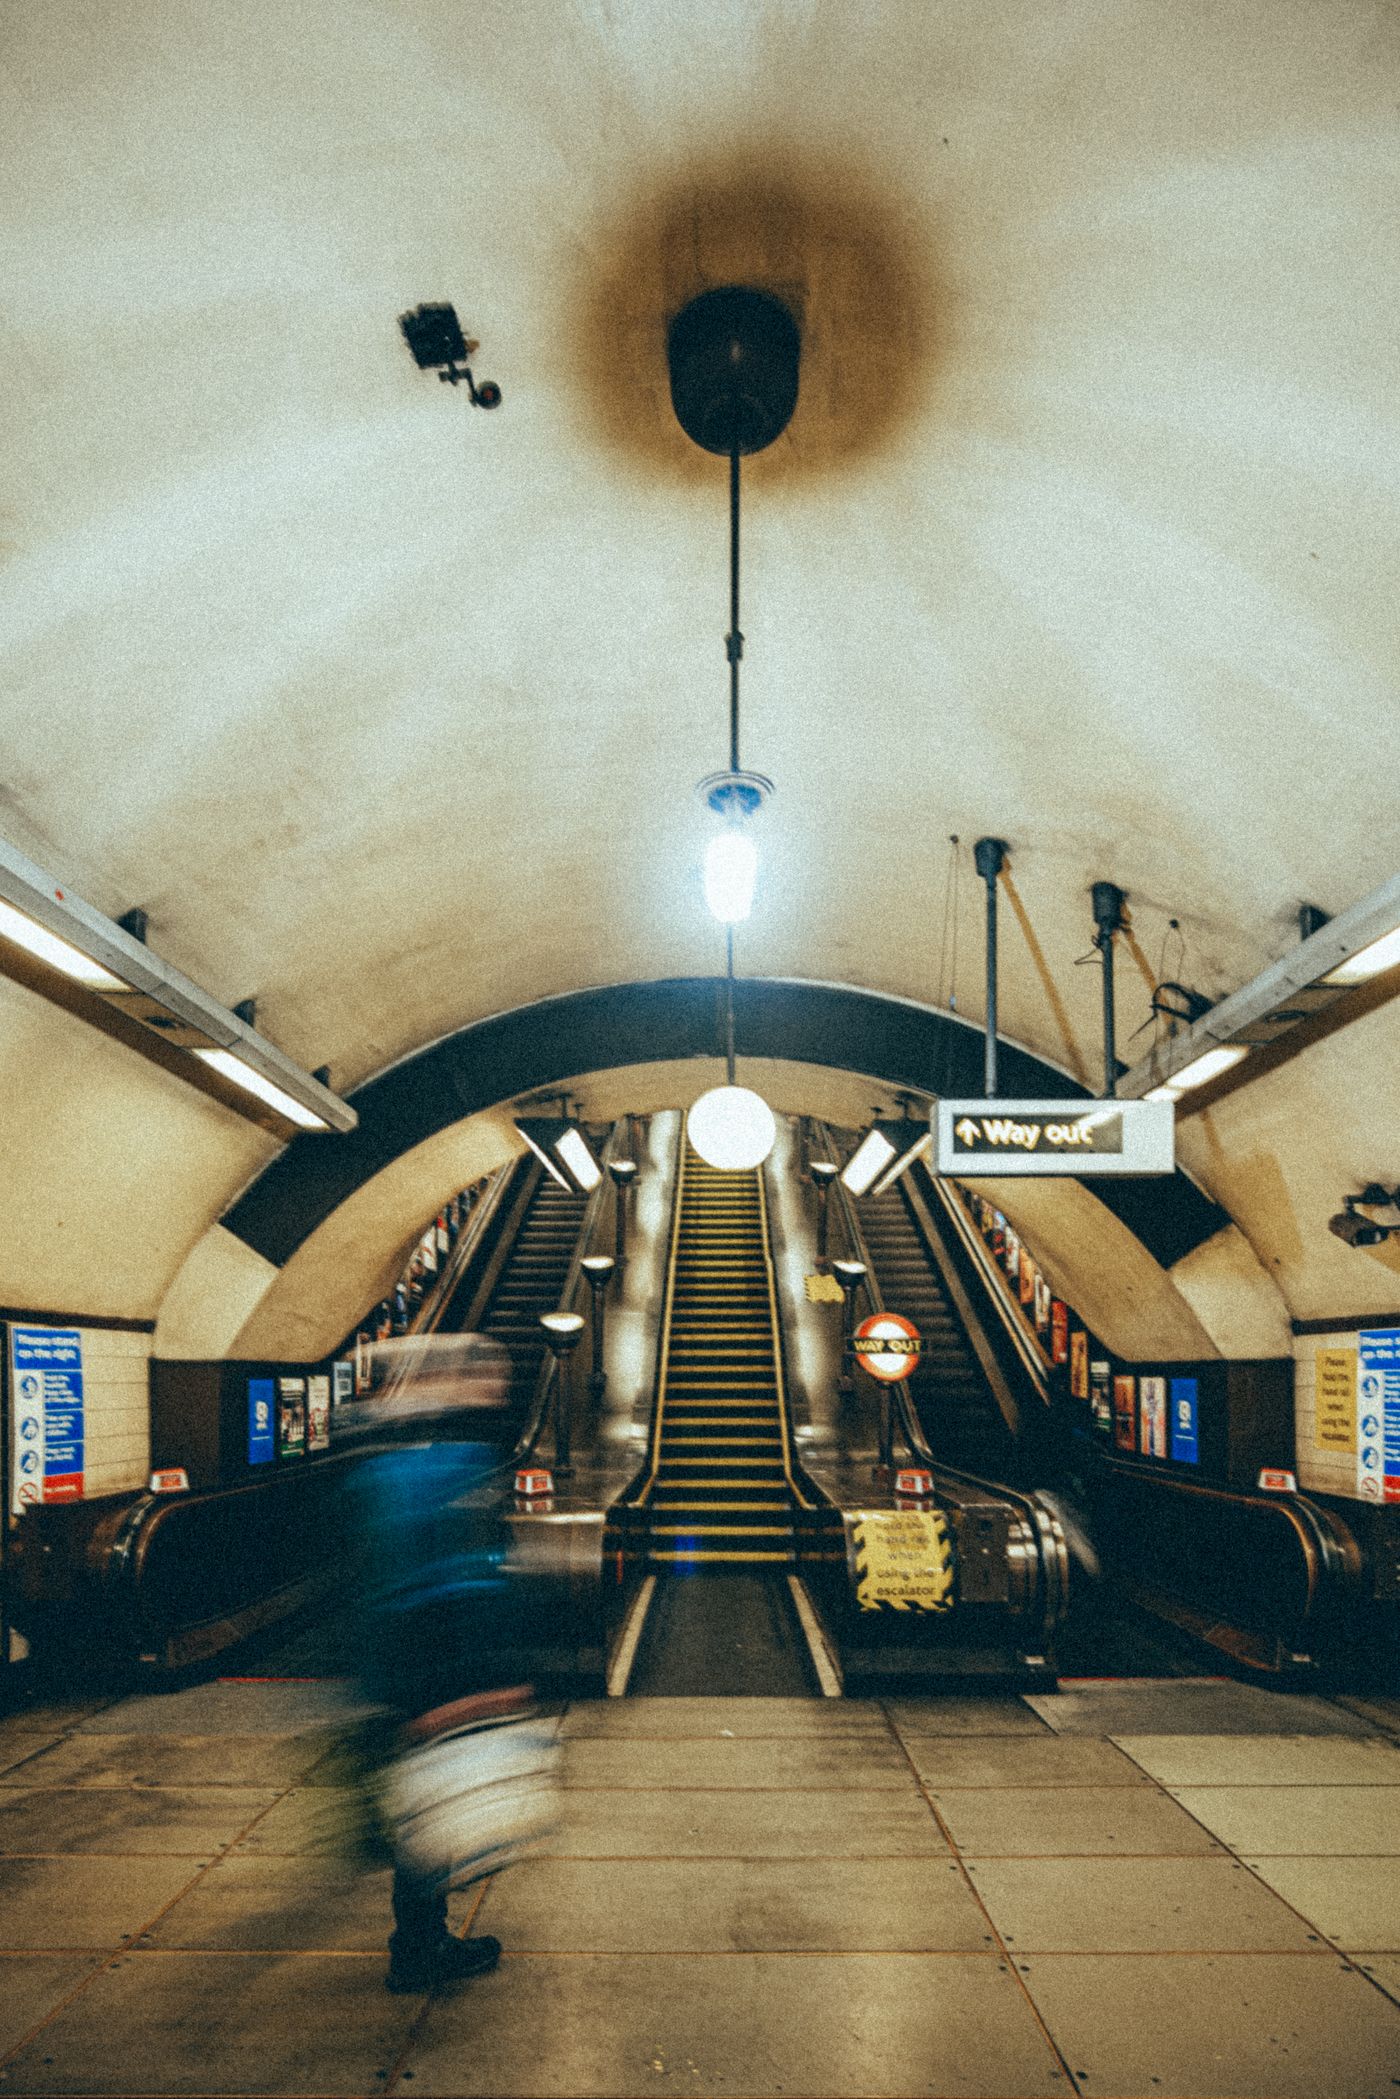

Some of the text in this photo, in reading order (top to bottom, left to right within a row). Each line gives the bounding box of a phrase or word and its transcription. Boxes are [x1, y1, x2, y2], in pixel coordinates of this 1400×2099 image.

[981, 1118, 1094, 1150] Way out
[854, 1339, 921, 1353] WAY OUT
[876, 1584, 936, 1596] escalator
